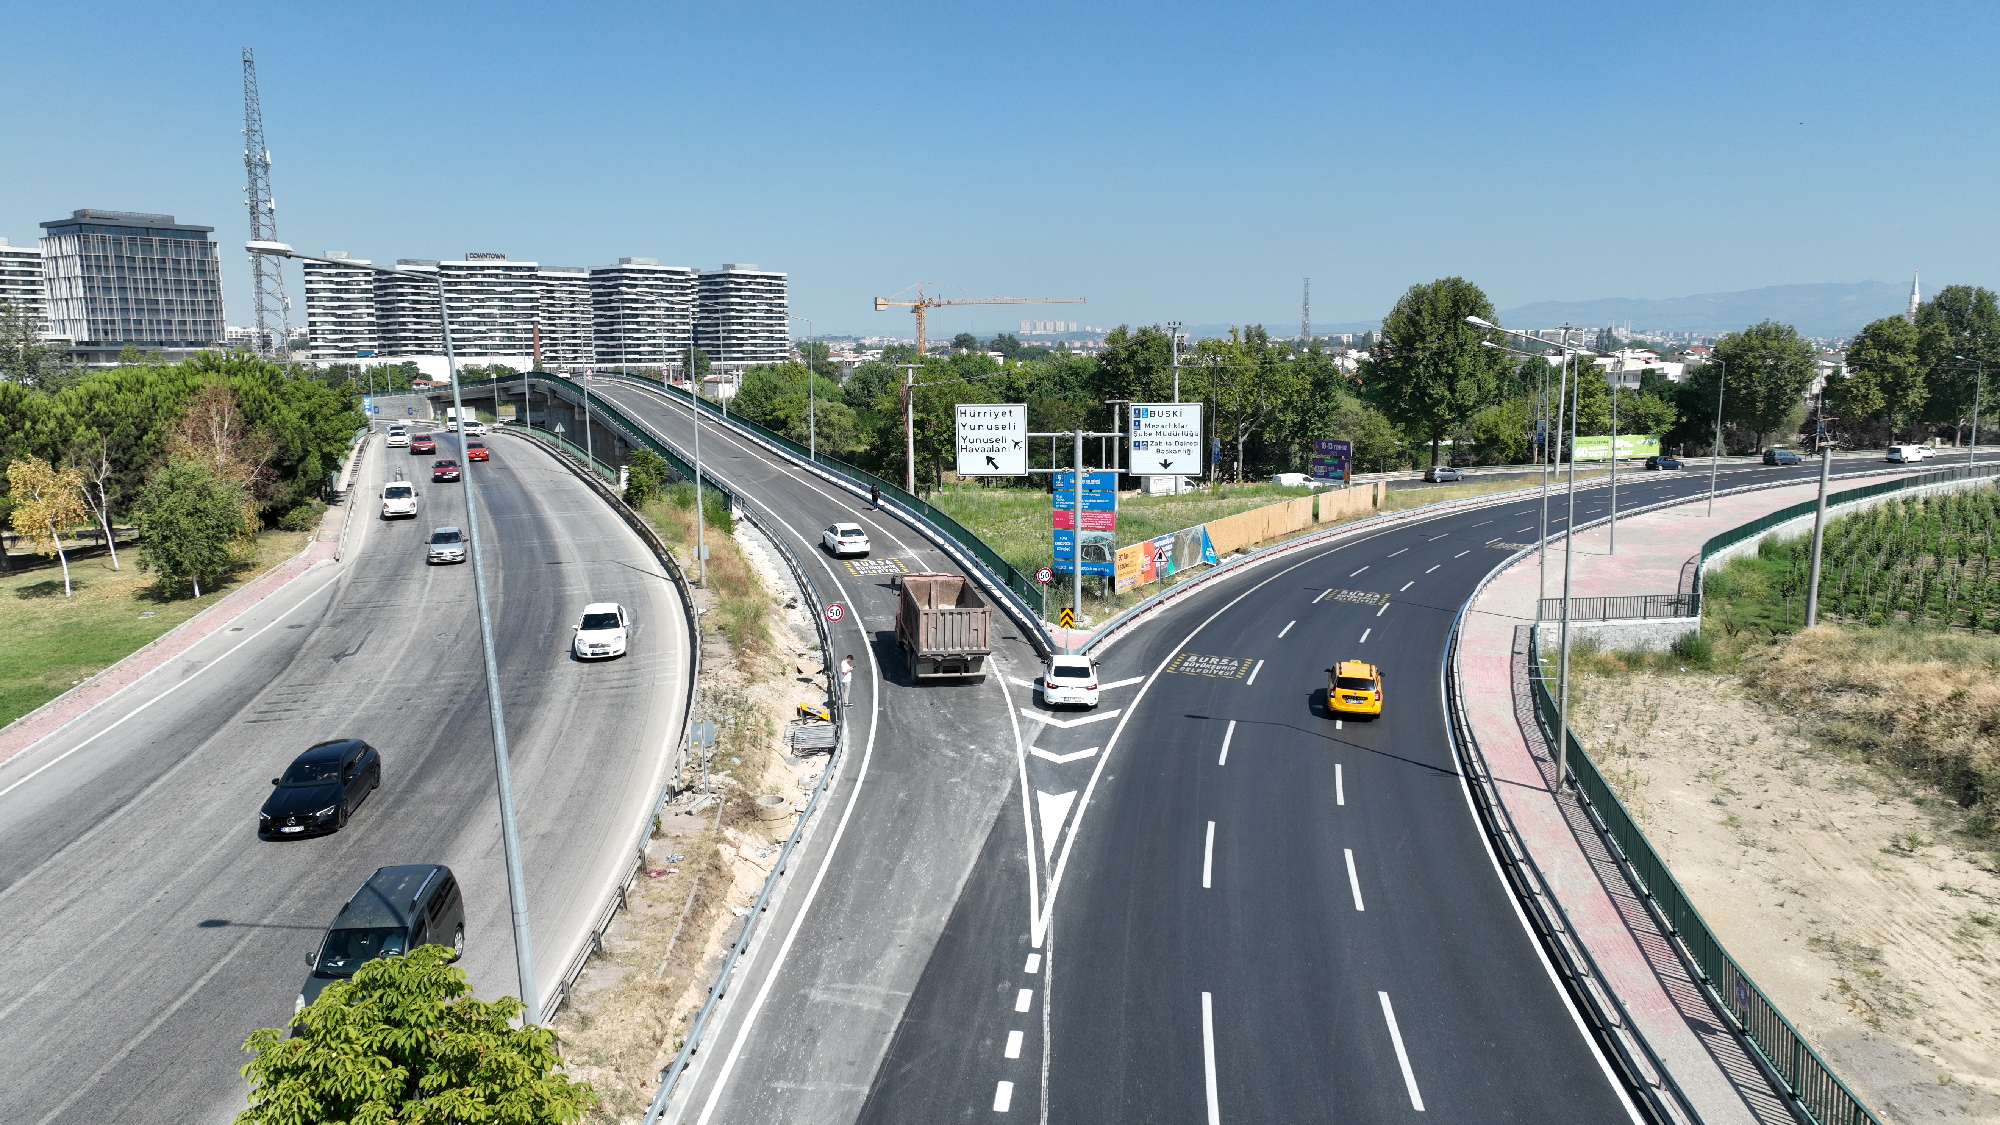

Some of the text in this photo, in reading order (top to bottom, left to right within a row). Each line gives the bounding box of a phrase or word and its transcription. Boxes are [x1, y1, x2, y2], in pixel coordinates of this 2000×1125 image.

[960, 409, 1013, 420] Hürriyet
[1150, 408, 1182, 418] BUSKİ
[960, 422, 1016, 430] Yunuseli
[960, 436, 1007, 444] Yunuseli
[830, 608, 840, 617] 50
[1186, 656, 1238, 666] BURSA
